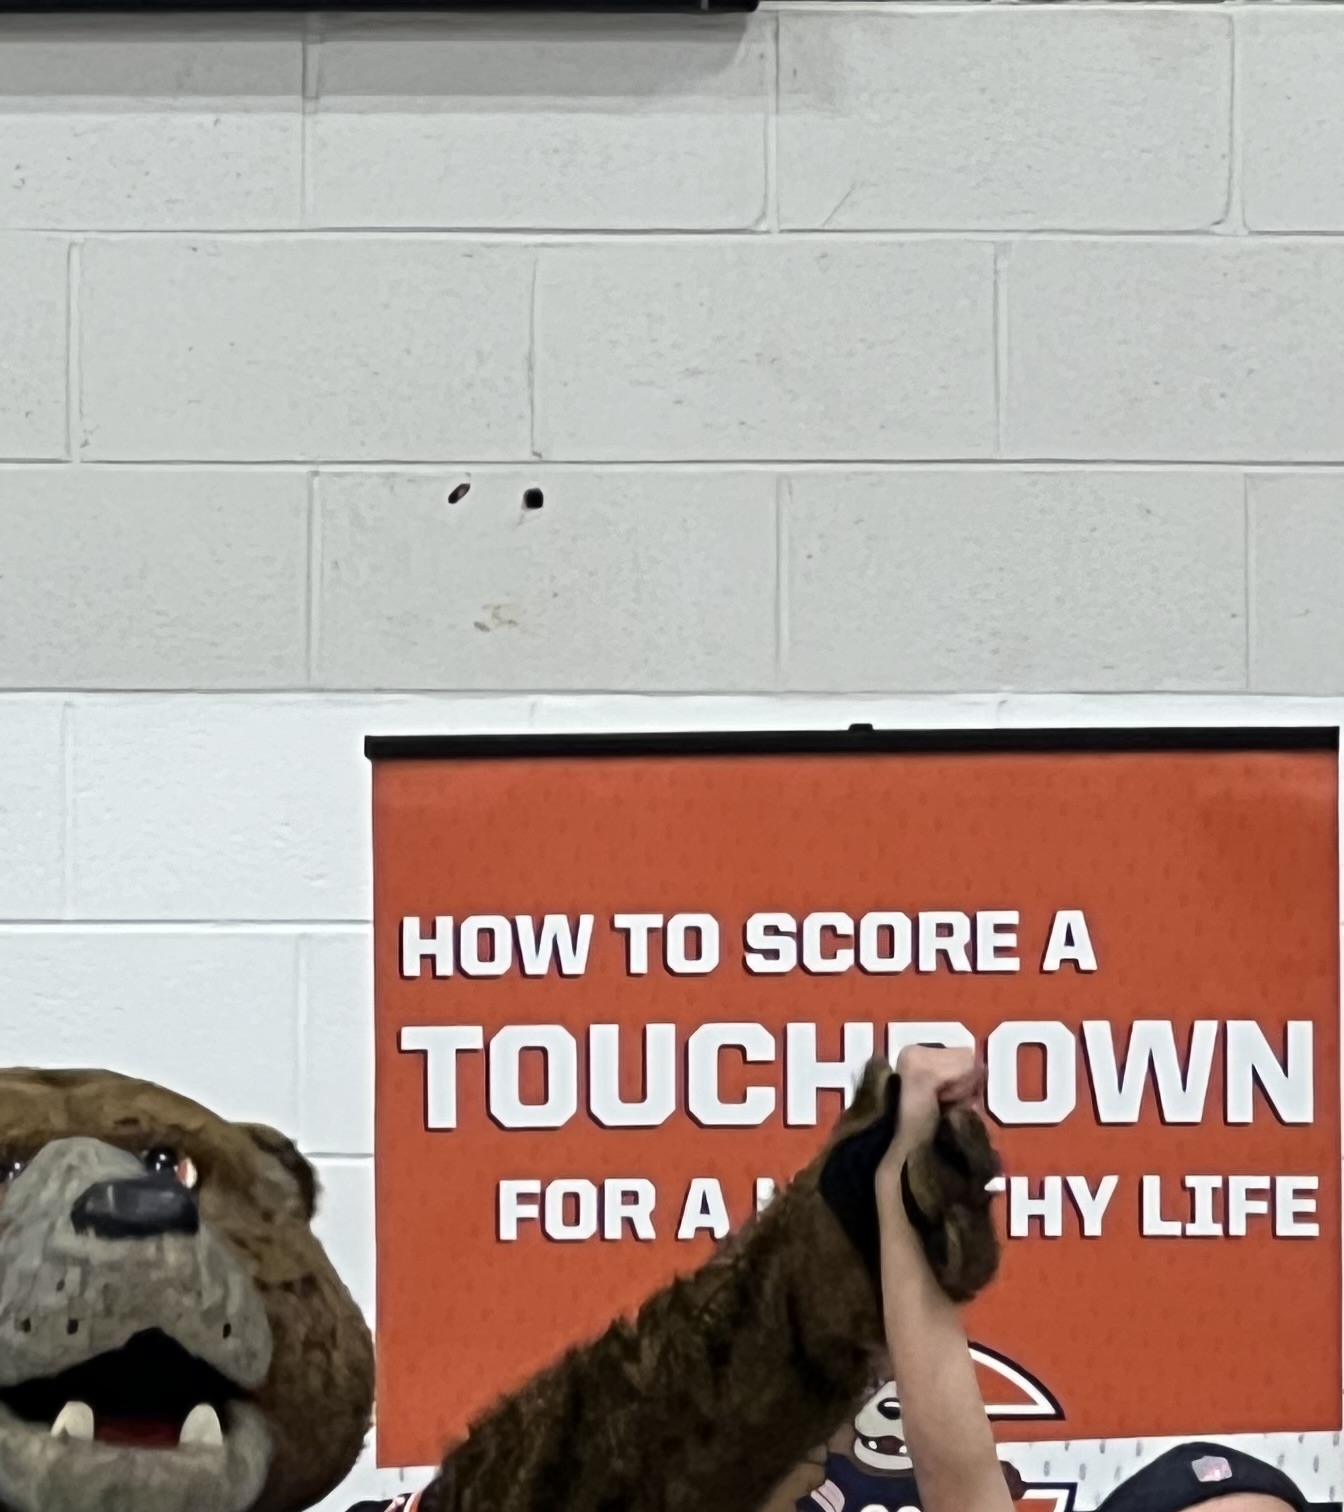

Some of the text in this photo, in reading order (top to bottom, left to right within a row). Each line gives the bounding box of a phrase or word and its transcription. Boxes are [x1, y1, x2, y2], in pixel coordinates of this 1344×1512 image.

[402, 910, 1099, 977] HOW TO SCORE A
[499, 1178, 656, 1241] FOR
[677, 1177, 731, 1240] A
[1142, 1175, 1320, 1237] LIFE
